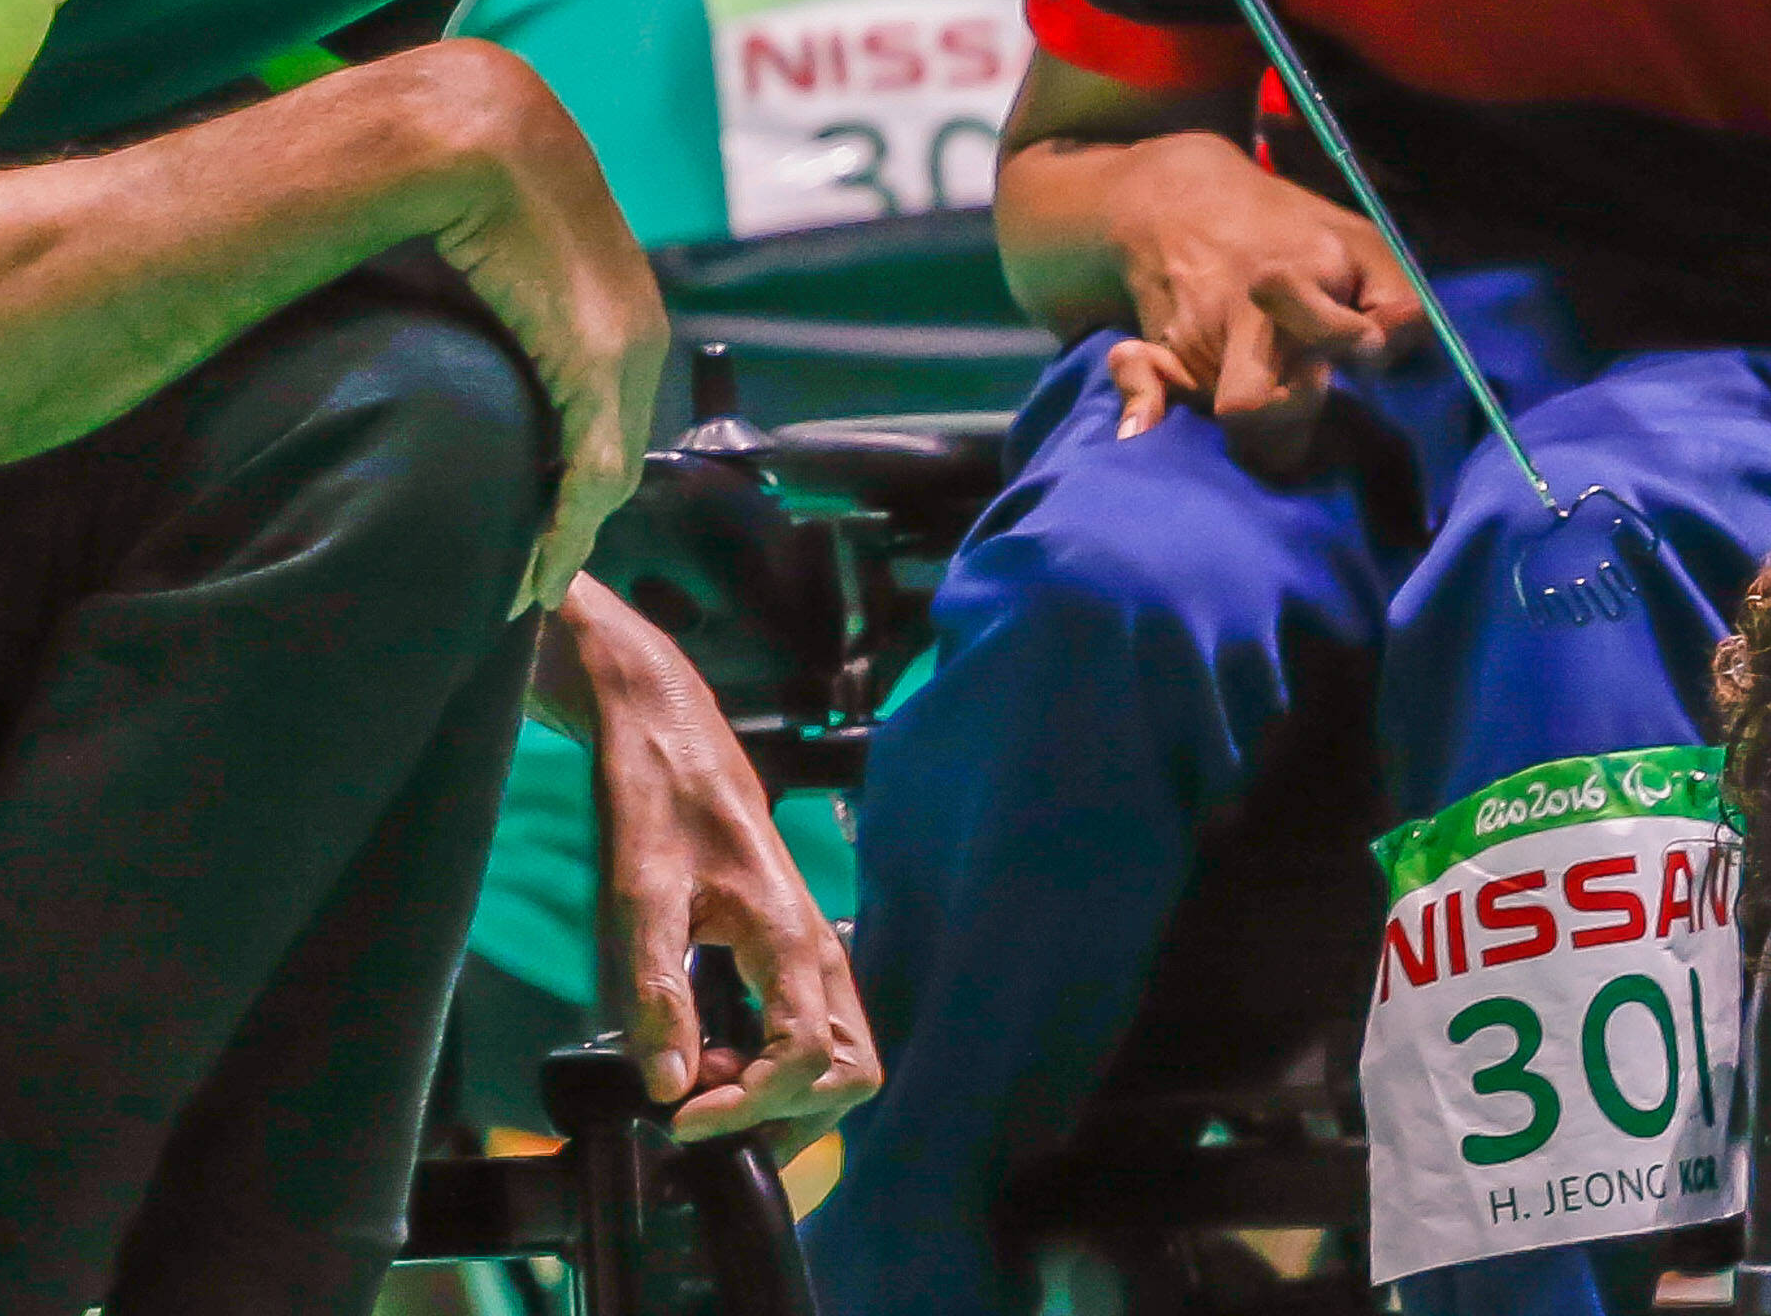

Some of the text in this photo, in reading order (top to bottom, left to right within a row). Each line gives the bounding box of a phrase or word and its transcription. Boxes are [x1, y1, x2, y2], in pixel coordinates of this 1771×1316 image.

[741, 20, 1030, 94] NISS
[1380, 847, 1727, 1005] NISSAN
[1447, 968, 1715, 1164] 301
[1489, 1187, 1530, 1224] H.
